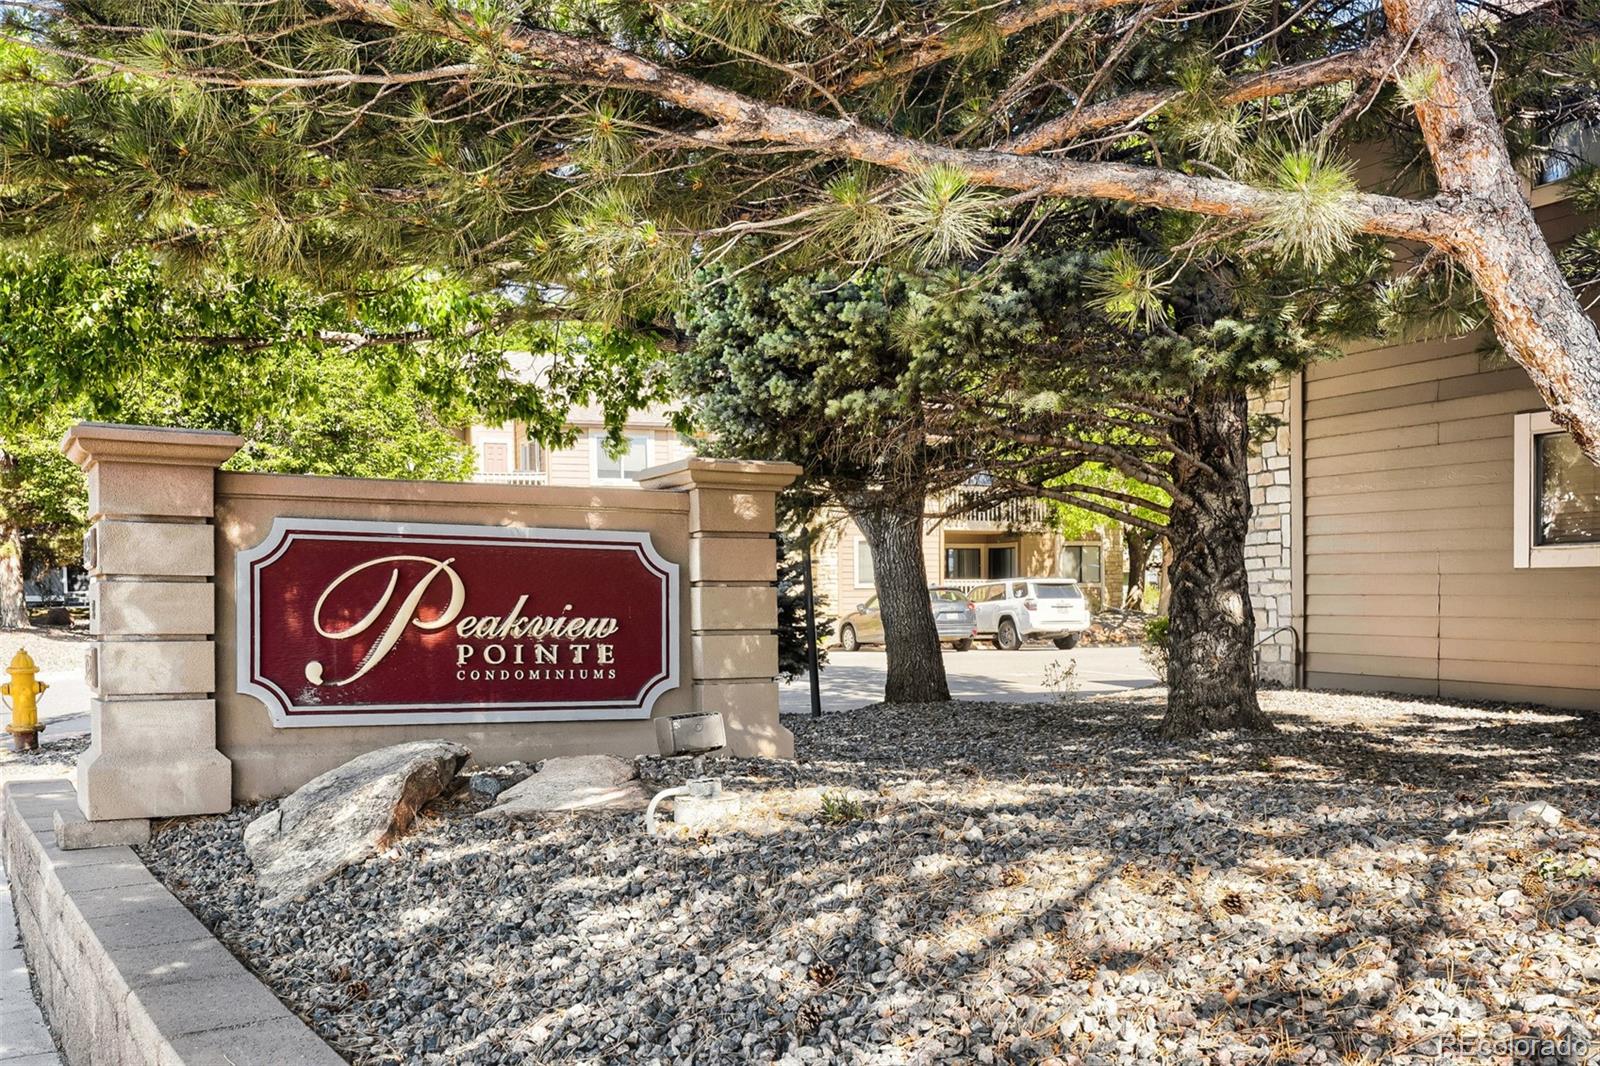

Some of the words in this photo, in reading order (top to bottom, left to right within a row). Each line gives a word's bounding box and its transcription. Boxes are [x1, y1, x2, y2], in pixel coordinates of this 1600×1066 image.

[305, 555, 619, 686] Peakview
[456, 644, 615, 665] POINTE
[456, 669, 616, 681] CONDOMINIUMS
